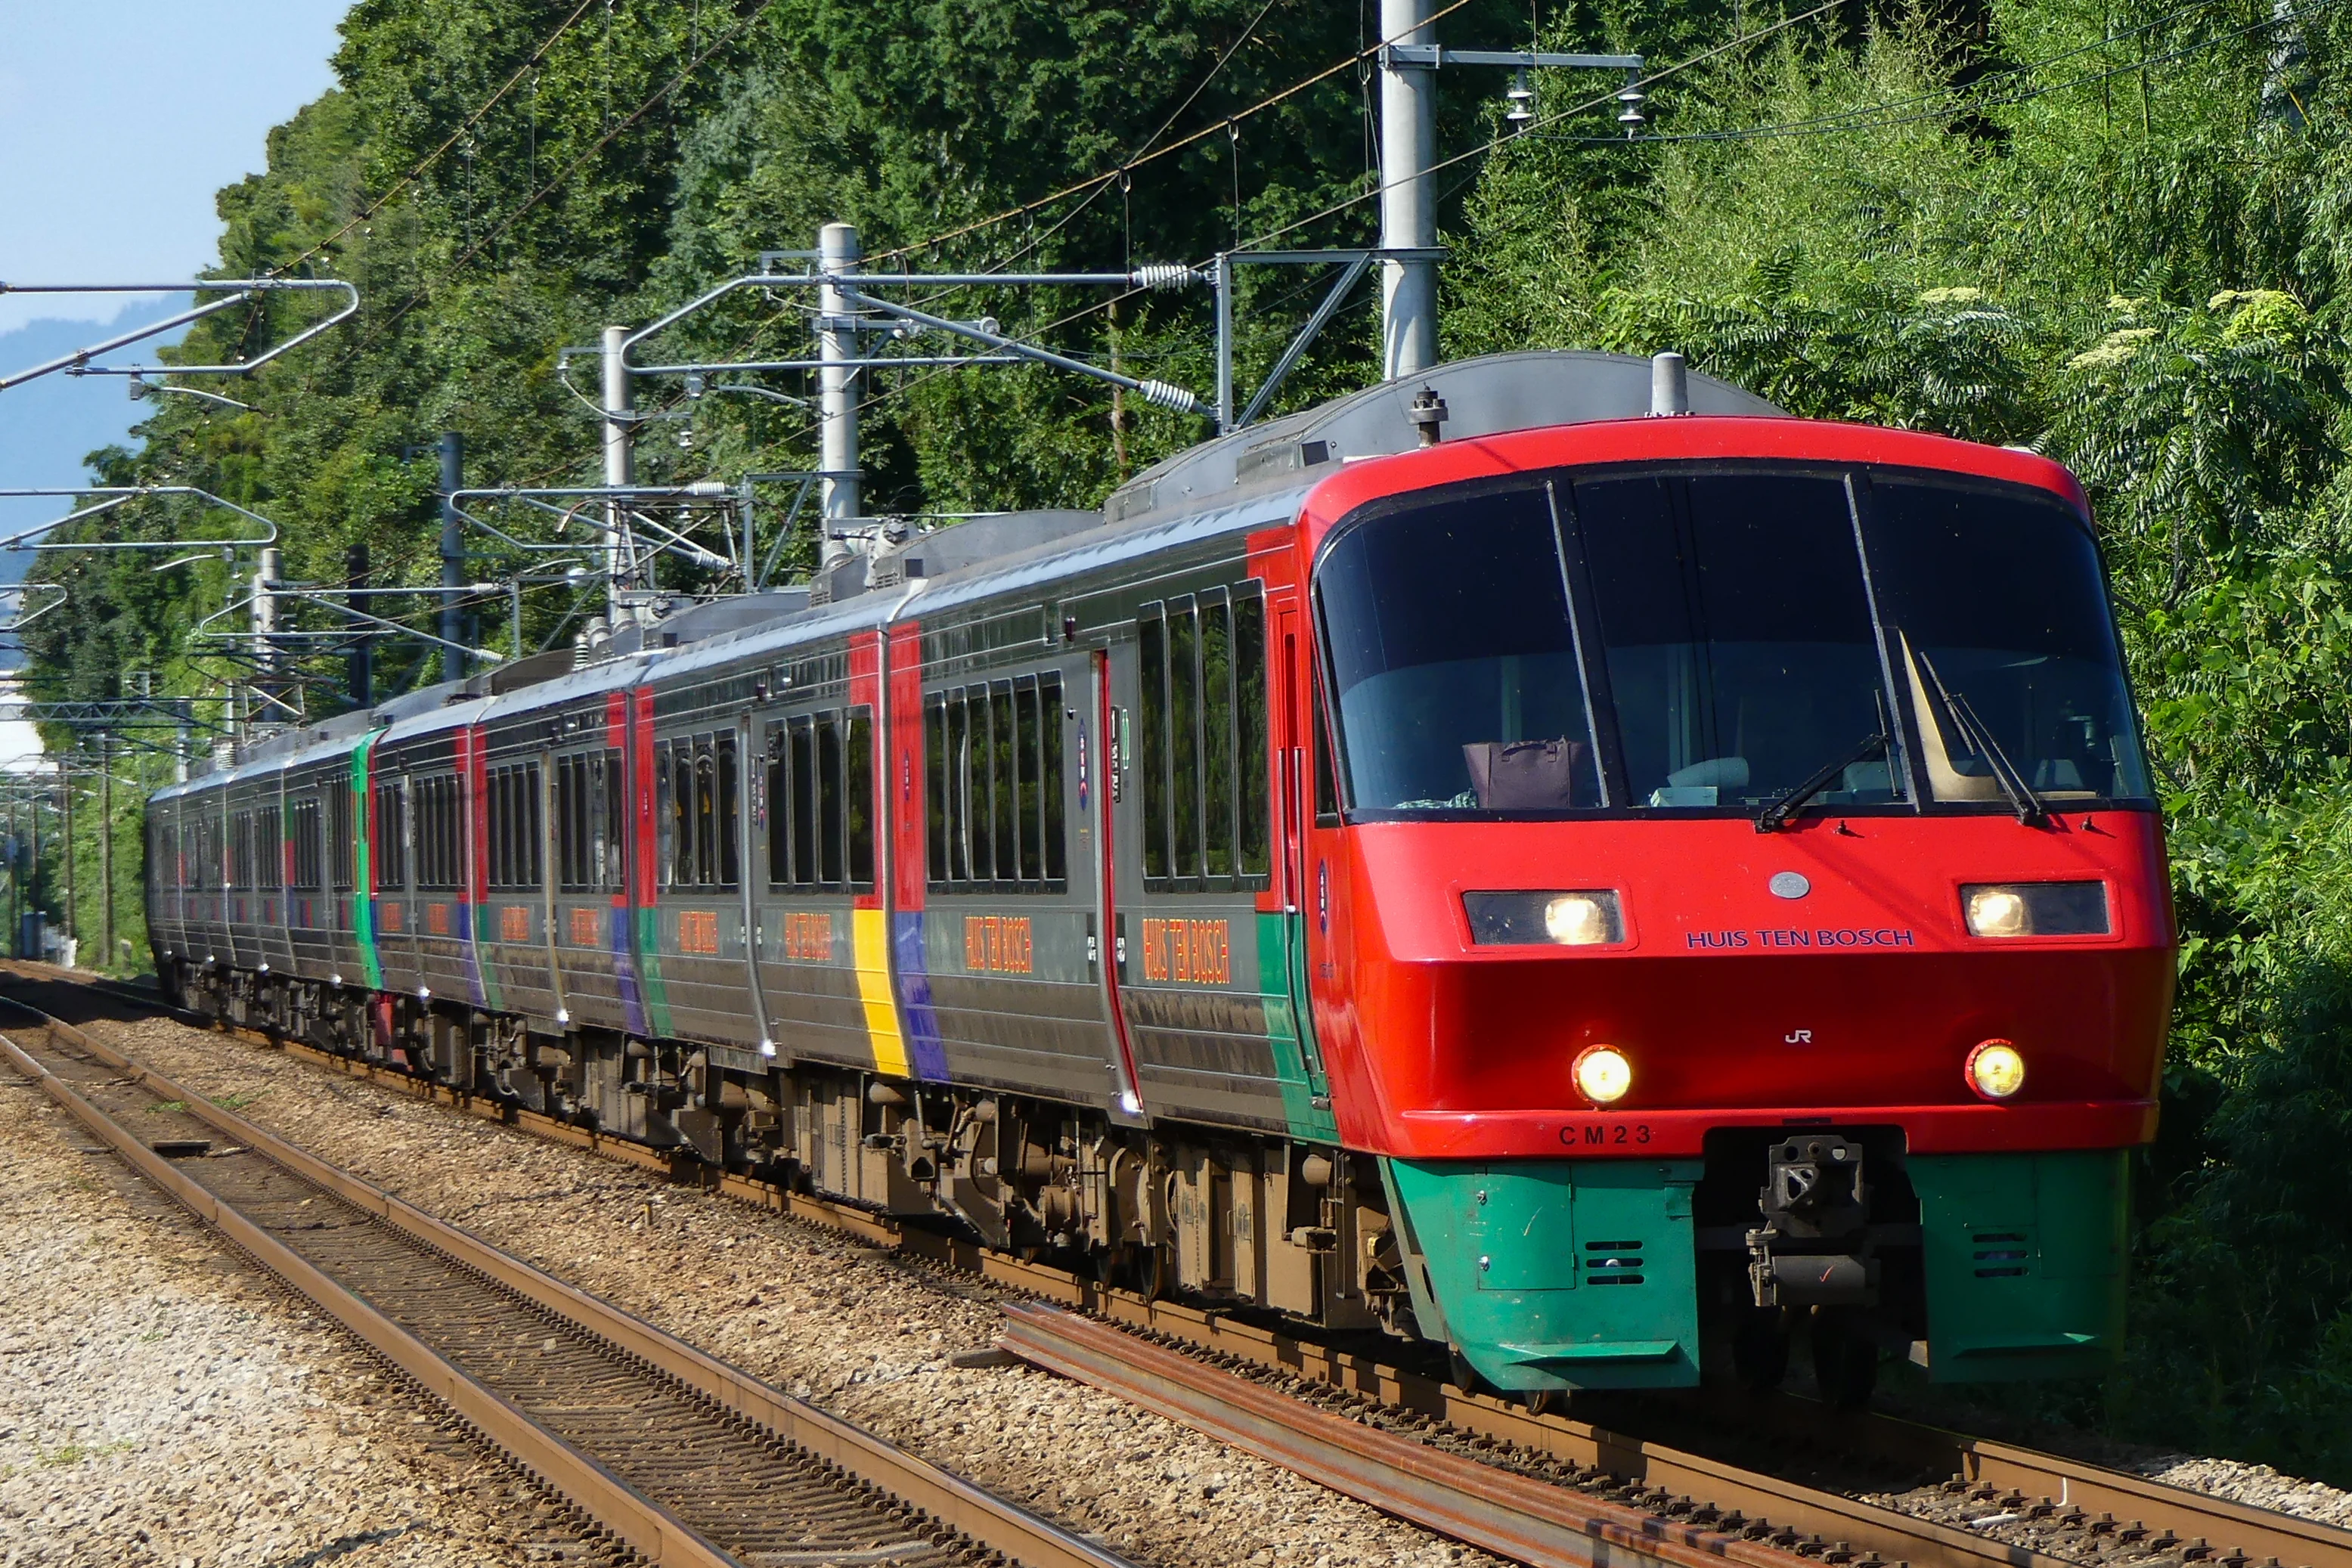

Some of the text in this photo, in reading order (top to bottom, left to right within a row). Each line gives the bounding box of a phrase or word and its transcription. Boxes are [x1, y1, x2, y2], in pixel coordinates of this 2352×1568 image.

[1686, 929, 1914, 949] HUIS TEN BOSCH
[1143, 919, 1230, 984] HUIS TEN BOSCH
[1785, 1030, 1811, 1043] JR
[1559, 1125, 1651, 1145] CM23
